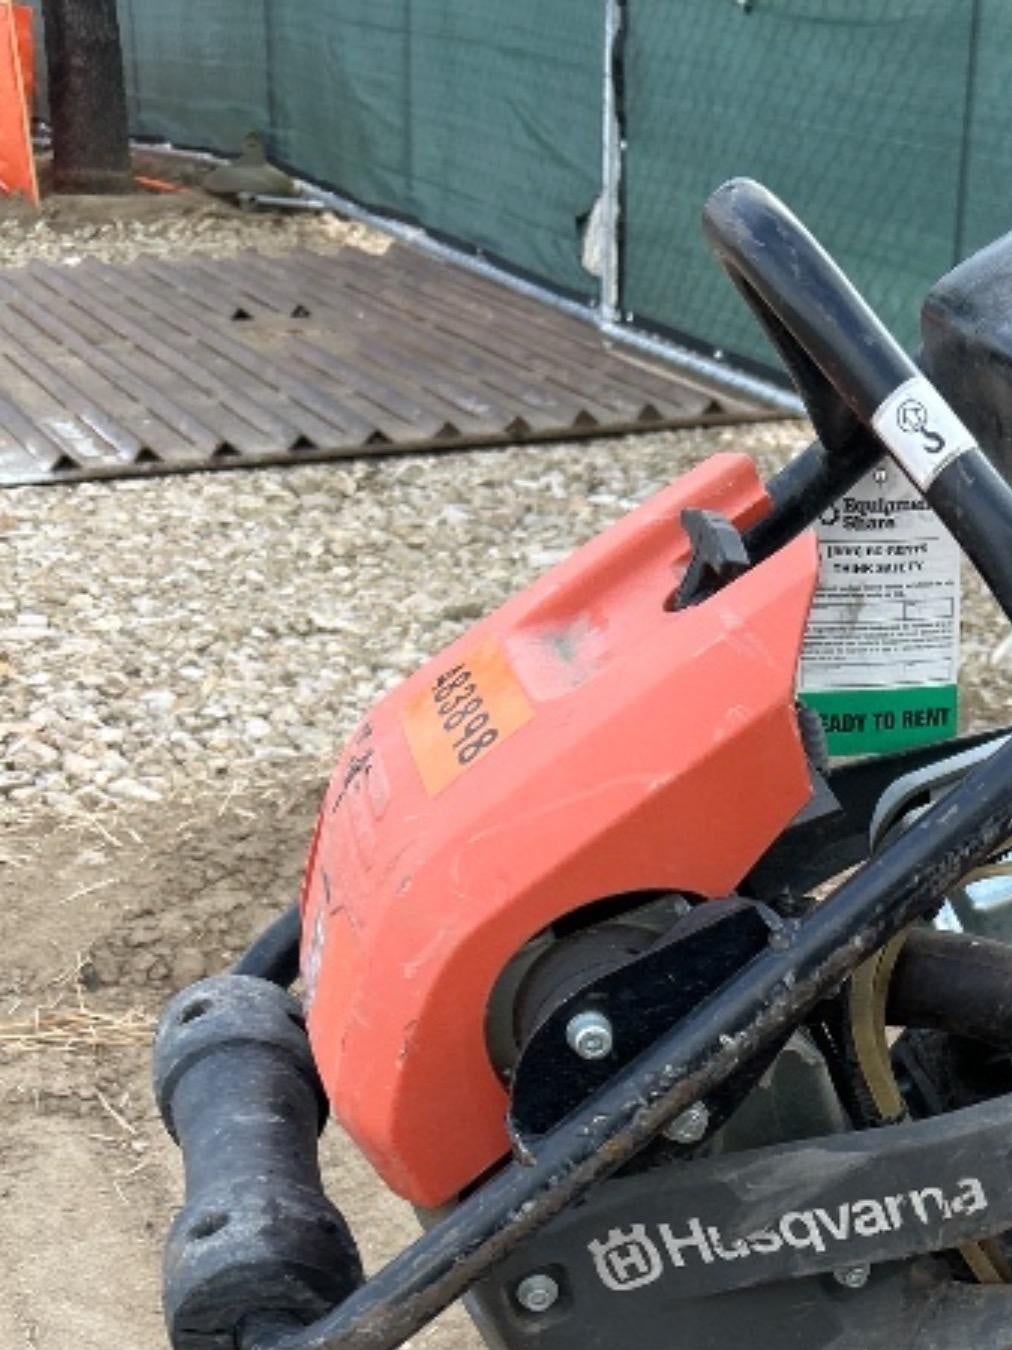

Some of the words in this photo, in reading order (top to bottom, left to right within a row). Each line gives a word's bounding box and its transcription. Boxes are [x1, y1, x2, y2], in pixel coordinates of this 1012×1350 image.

[819, 713, 867, 733] EADY
[873, 710, 896, 731] TO
[902, 707, 951, 729] RENT
[656, 1177, 988, 1268] Husqvarna
